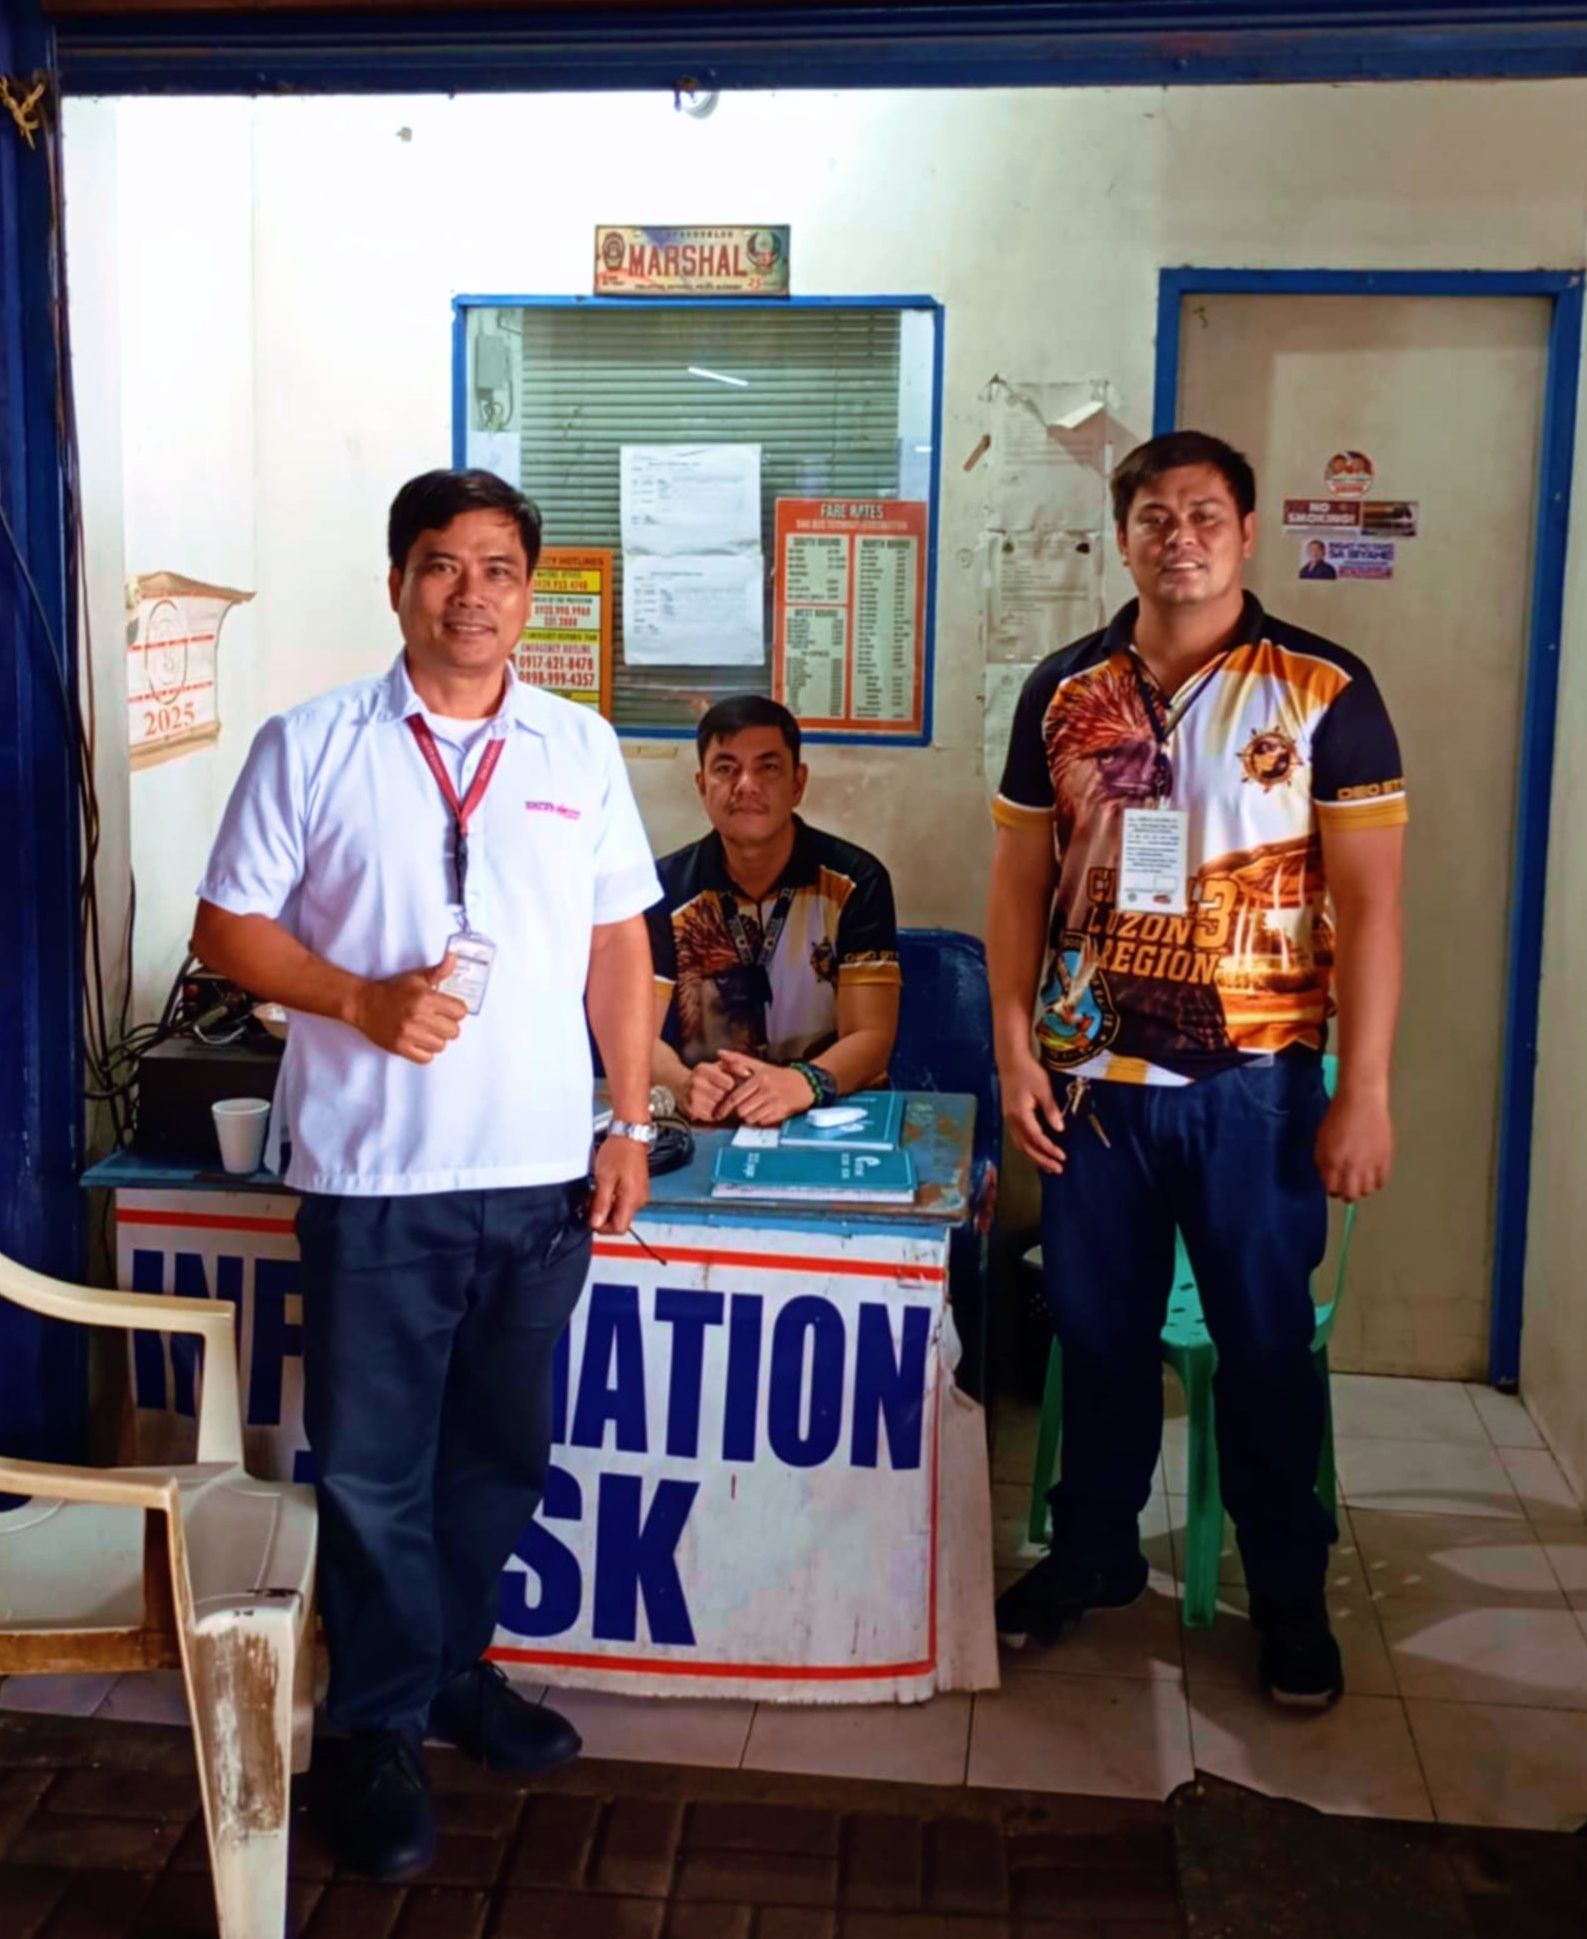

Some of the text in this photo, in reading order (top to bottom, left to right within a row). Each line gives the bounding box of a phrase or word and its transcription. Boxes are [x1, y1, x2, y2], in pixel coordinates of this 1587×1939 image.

[628, 244, 748, 278] MARSHAL
[820, 503, 847, 518] FARE
[1308, 502, 1330, 512] NO
[143, 702, 196, 736] 2025
[1088, 877, 1240, 949] LUZON 3
[132, 1249, 932, 1471] INFATION
